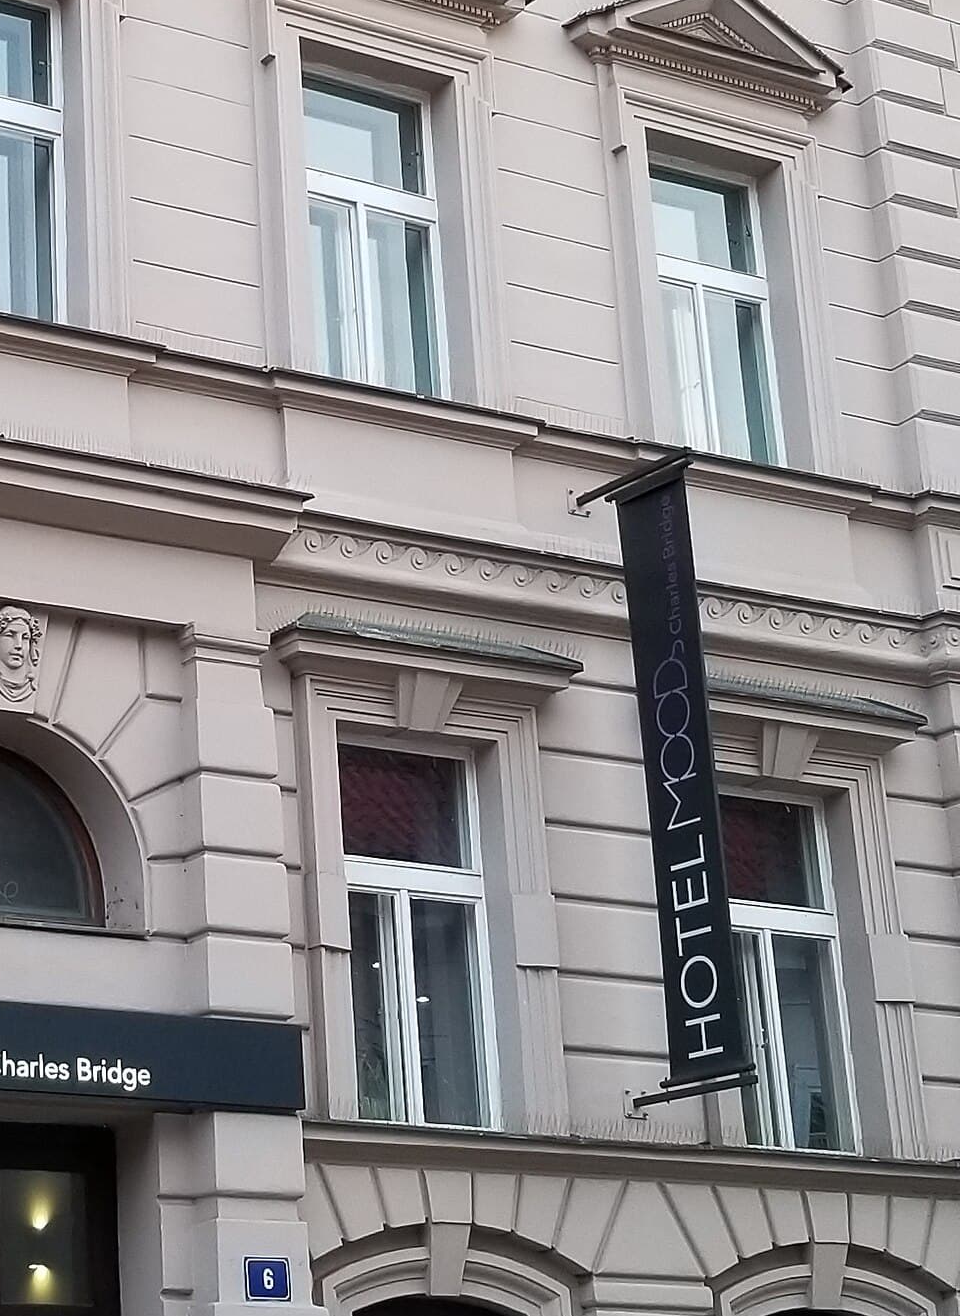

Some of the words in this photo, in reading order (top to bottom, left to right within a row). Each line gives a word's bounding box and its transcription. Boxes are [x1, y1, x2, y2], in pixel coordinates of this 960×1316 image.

[670, 833, 724, 1060] HOTEL
[77, 1057, 151, 1092] Bridge
[263, 1268, 274, 1290] 6
